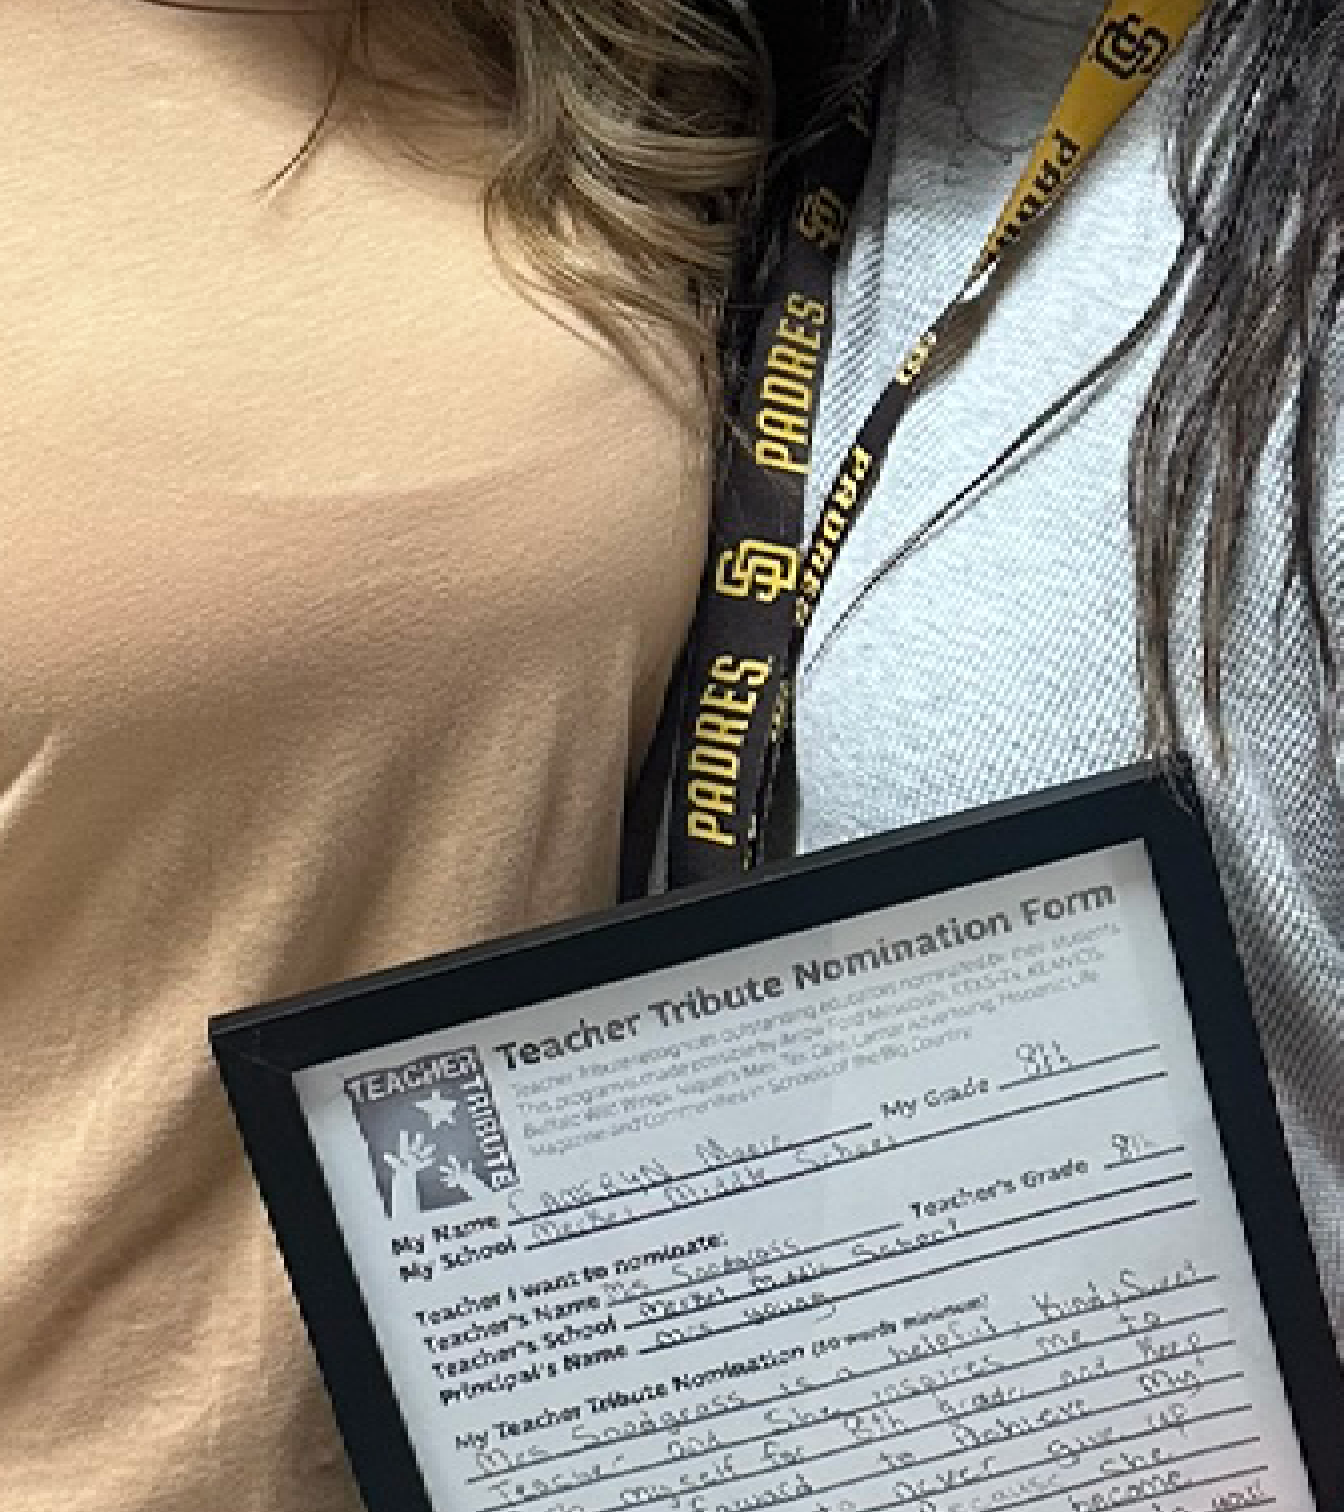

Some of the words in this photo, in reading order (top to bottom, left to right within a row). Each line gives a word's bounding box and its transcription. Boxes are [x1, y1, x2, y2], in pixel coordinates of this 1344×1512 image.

[755, 291, 828, 476] PADRES
[687, 654, 772, 848] PADRES
[493, 1014, 639, 1068] Teacher
[648, 976, 780, 1025] Tribute
[792, 913, 1010, 988] Nomination
[1020, 884, 1113, 924] Form
[349, 1049, 479, 1104] TEACHER
[881, 1100, 916, 1117] My
[924, 1077, 987, 1106] Grade
[461, 1075, 517, 1192] TRIBUTE
[910, 1180, 1015, 1217] Teacher's
[1020, 1159, 1087, 1187] Grade
[391, 1236, 424, 1255] My
[432, 1216, 497, 1241] Name
[399, 1263, 432, 1281] My
[440, 1236, 515, 1268] School
[415, 1293, 499, 1324] Teacher
[523, 1272, 578, 1297] want
[582, 1266, 608, 1281] to
[615, 1235, 725, 1273] nominate:
[424, 1314, 528, 1351] Teacher's
[533, 1296, 599, 1319] Name
[432, 1340, 537, 1377] Teacher's
[542, 1314, 616, 1348] School
[439, 1363, 556, 1405] Principal's
[563, 1345, 626, 1370] Name
[455, 1431, 487, 1450] My
[494, 1407, 580, 1438] Teacher
[587, 1384, 666, 1412] Tribute
[672, 1347, 803, 1390] Nomination
